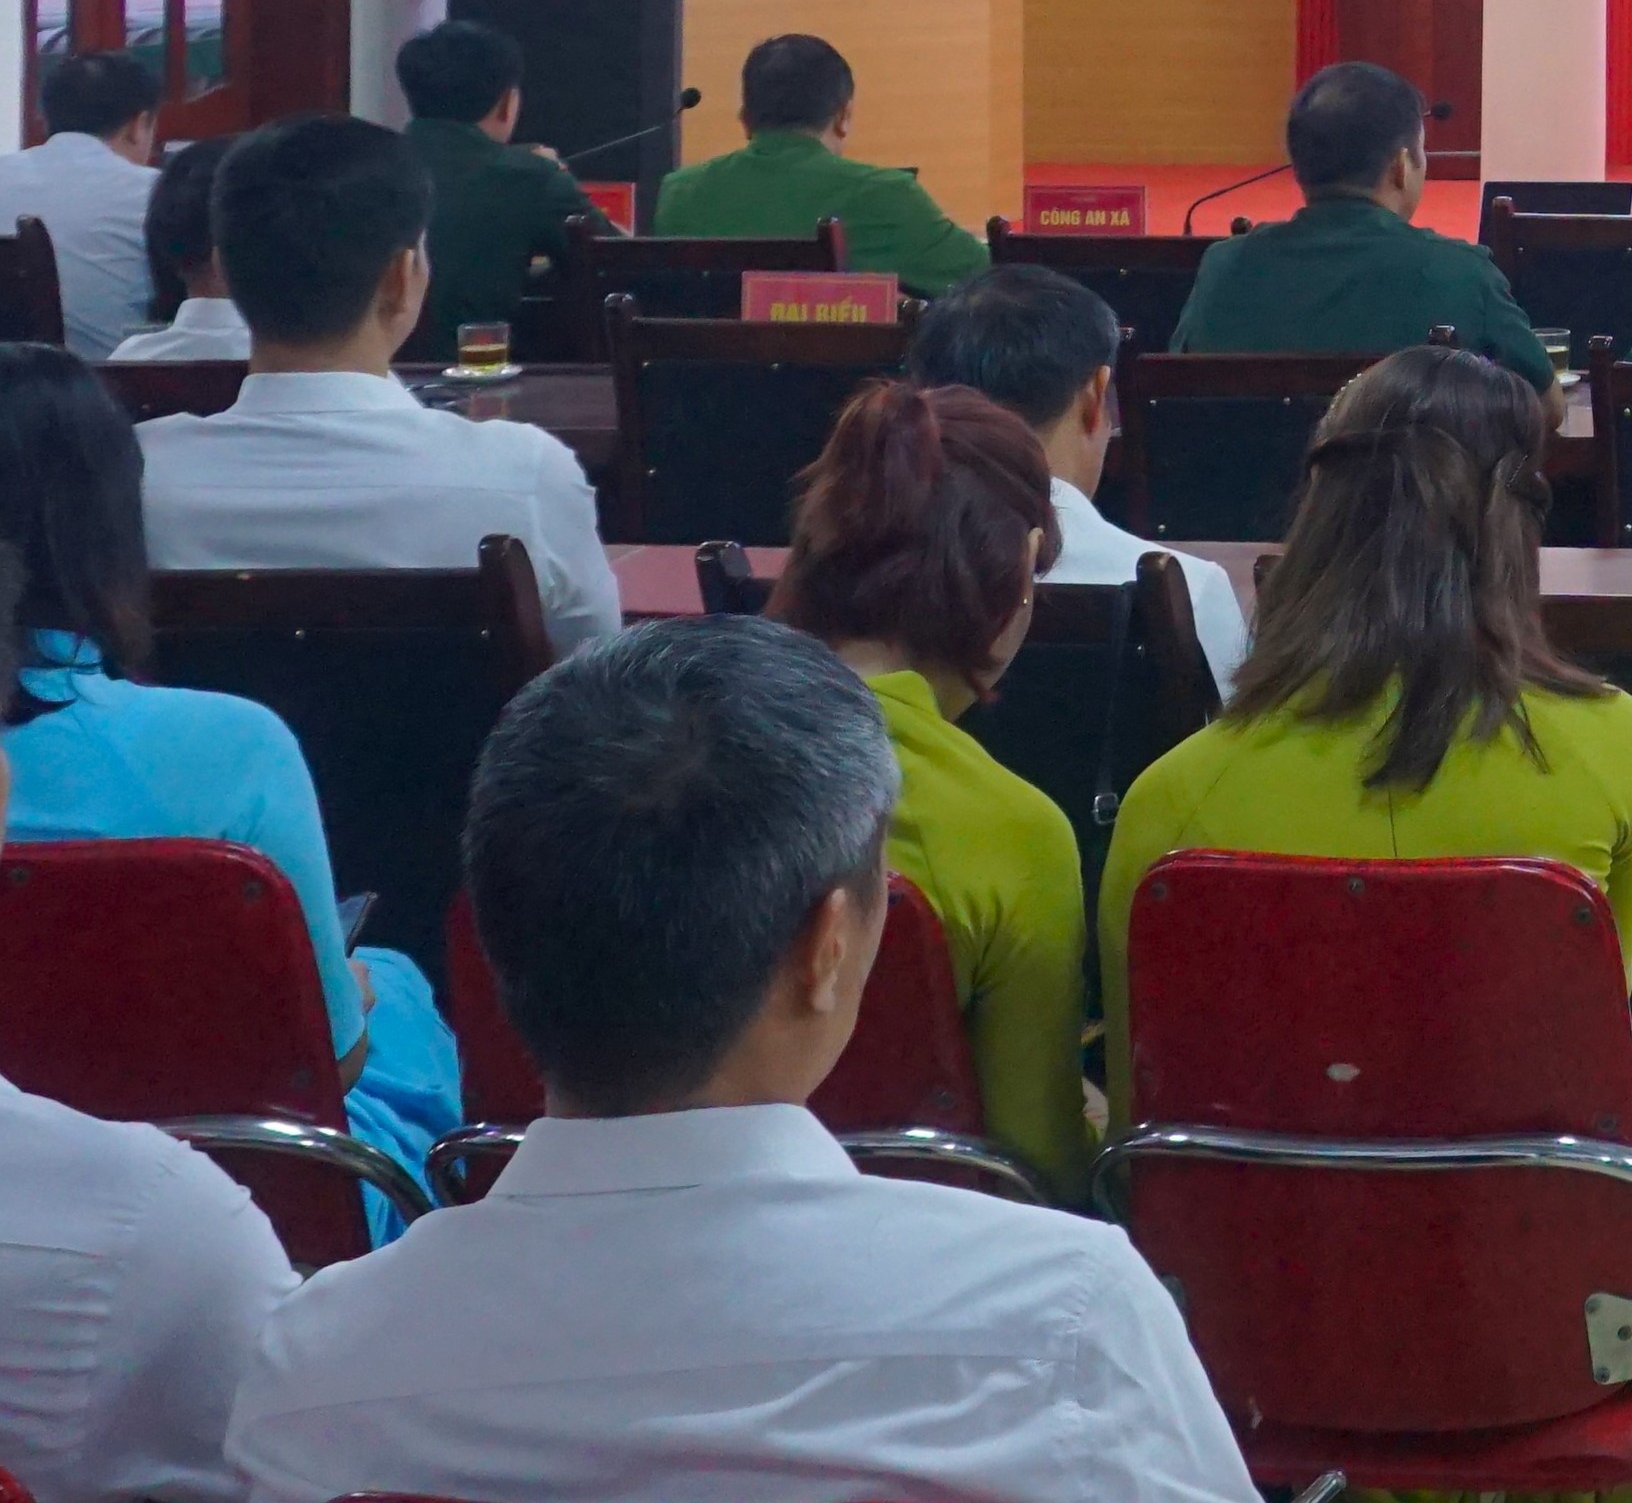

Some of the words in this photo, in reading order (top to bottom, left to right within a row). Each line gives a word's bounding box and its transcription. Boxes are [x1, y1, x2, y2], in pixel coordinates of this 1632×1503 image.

[1040, 206, 1080, 226] CÔNG
[1085, 209, 1106, 226] AN
[1110, 206, 1130, 226] XÃ
